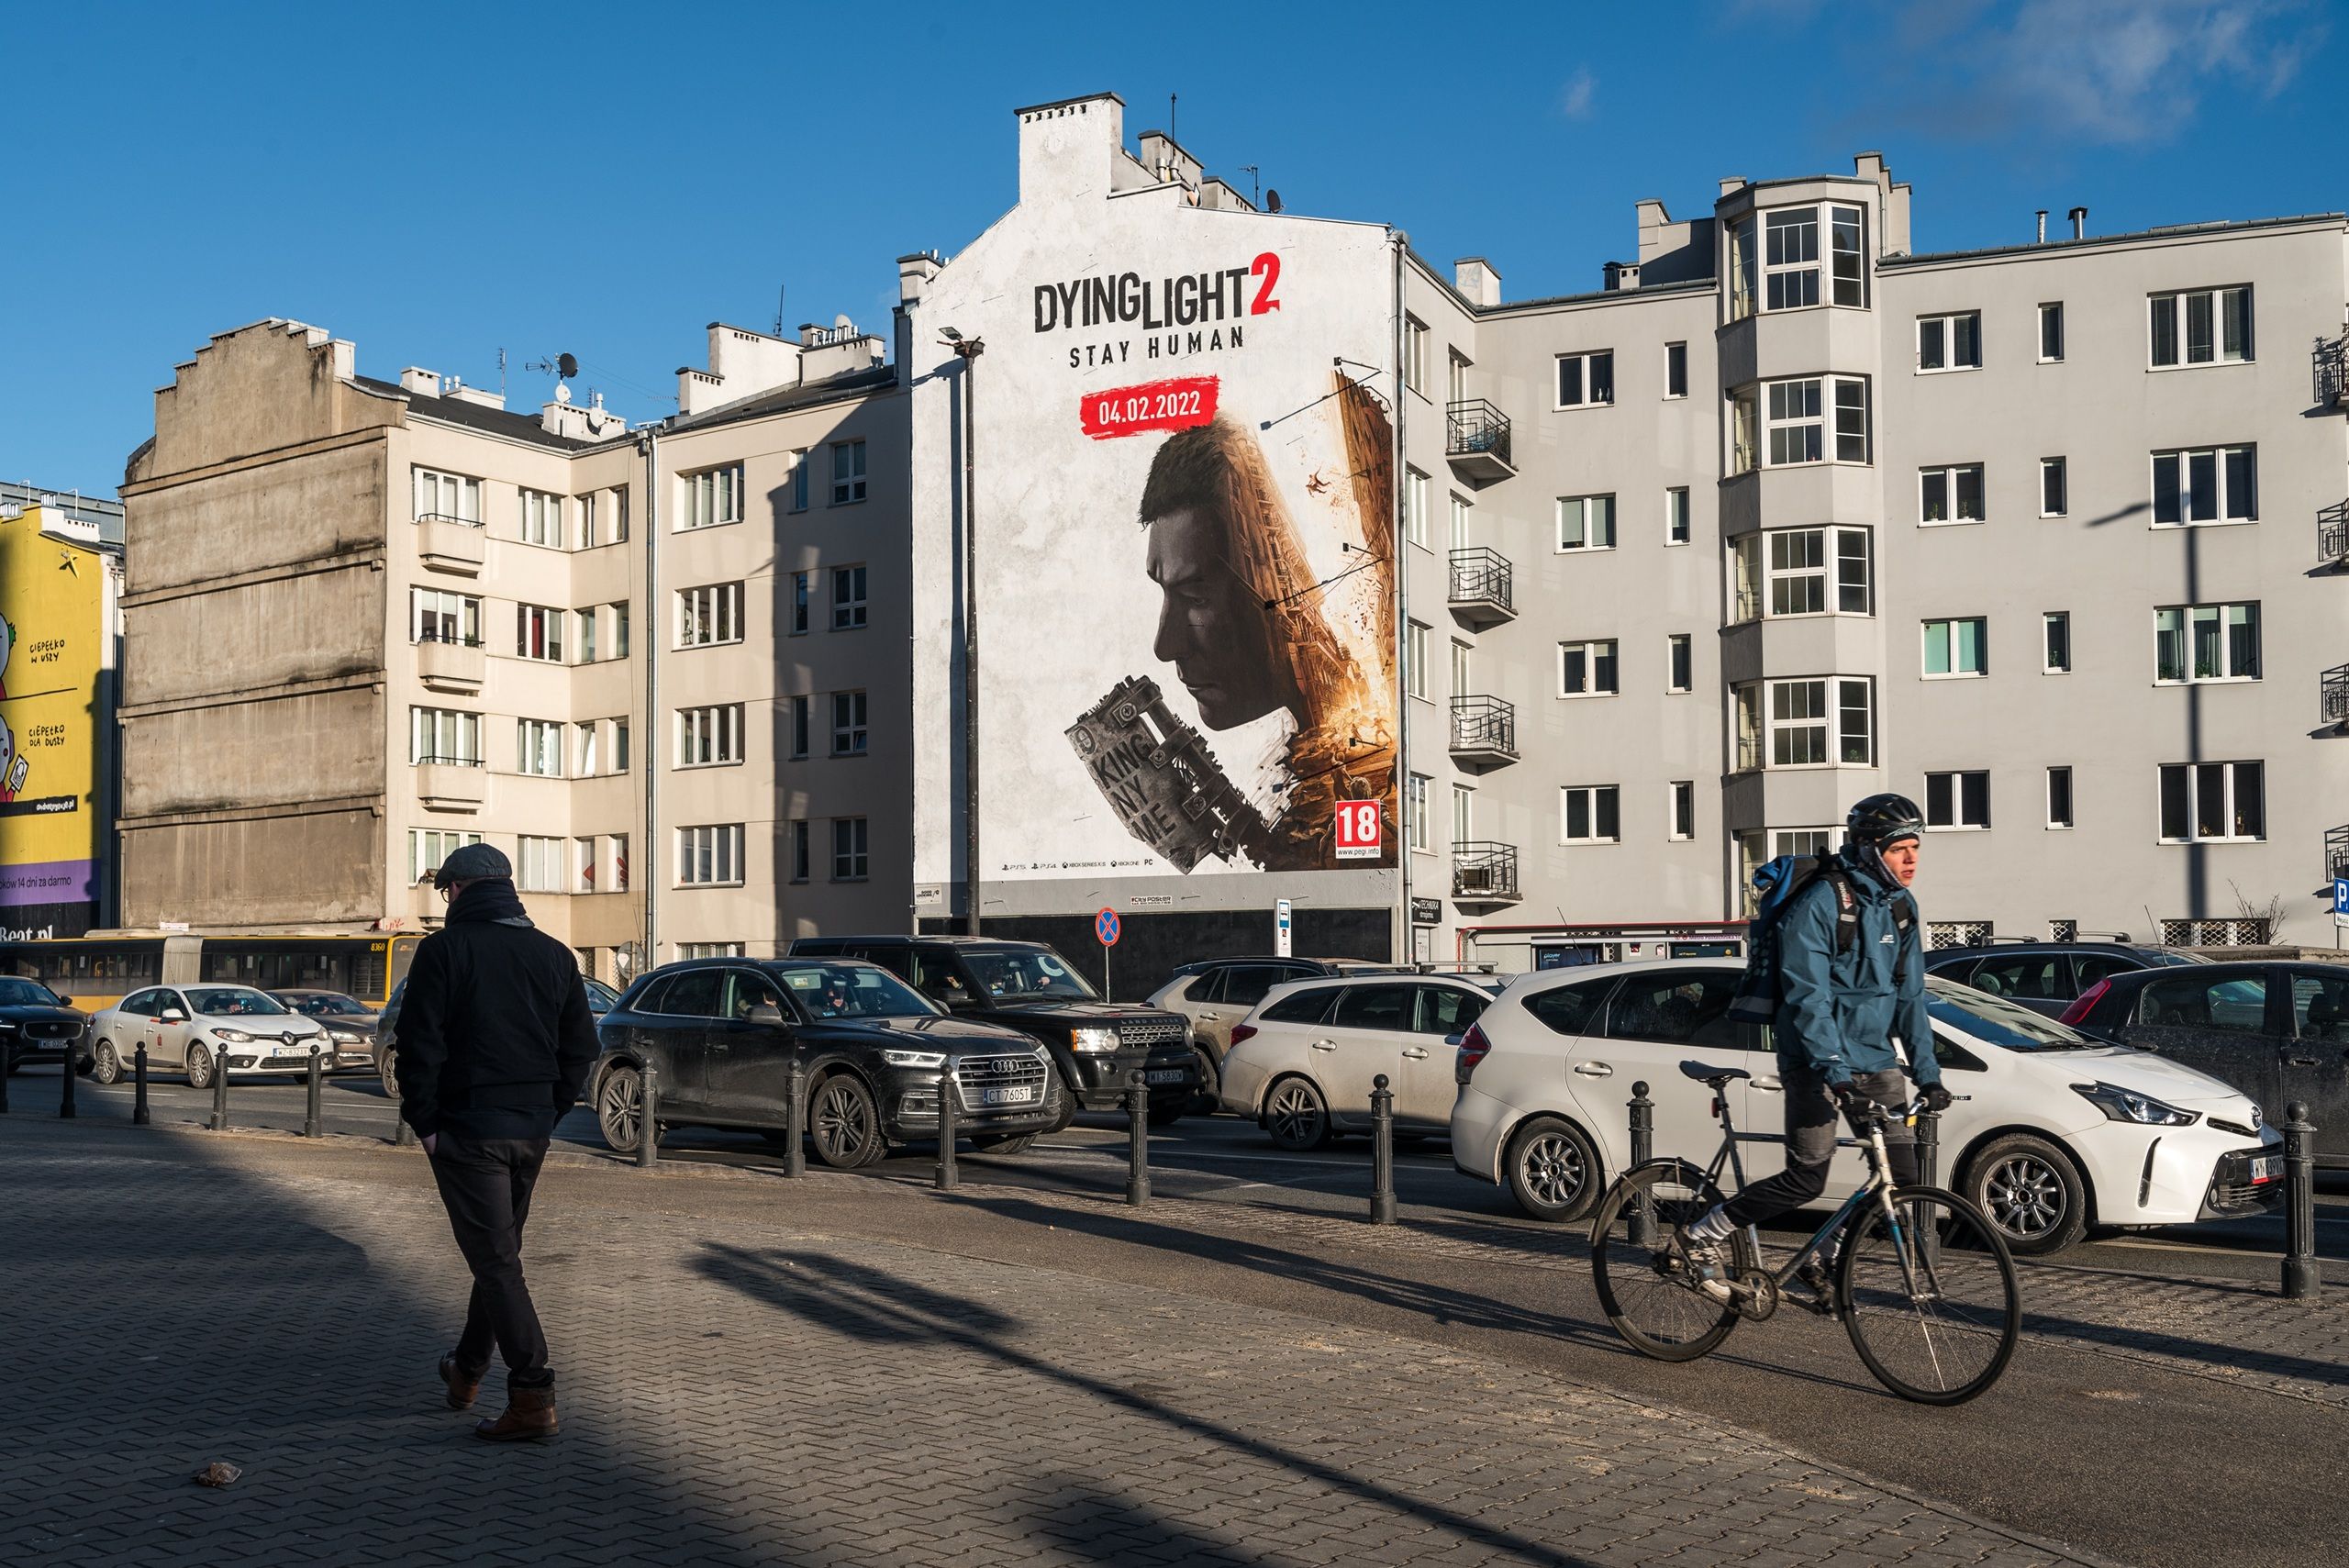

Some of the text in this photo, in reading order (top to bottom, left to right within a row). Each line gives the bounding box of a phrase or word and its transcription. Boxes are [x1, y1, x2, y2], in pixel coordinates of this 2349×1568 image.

[1070, 326, 1242, 368] STAY HUMAN
[1099, 391, 1200, 425] 04.02.2022
[29, 639, 65, 653] CIEPEŁKO
[41, 652, 59, 662] USZY
[29, 737, 65, 746] DLA DUSZY
[1111, 775, 1149, 820] NY
[1340, 806, 1377, 842] 18
[1338, 848, 1379, 856] www.pegi.info
[18, 877, 25, 888] 14
[27, 876, 38, 888] dni
[39, 878, 47, 887] za
[48, 875, 72, 887] darmo
[371, 942, 385, 951] 8360
[989, 1088, 1029, 1102] CT 7605T
